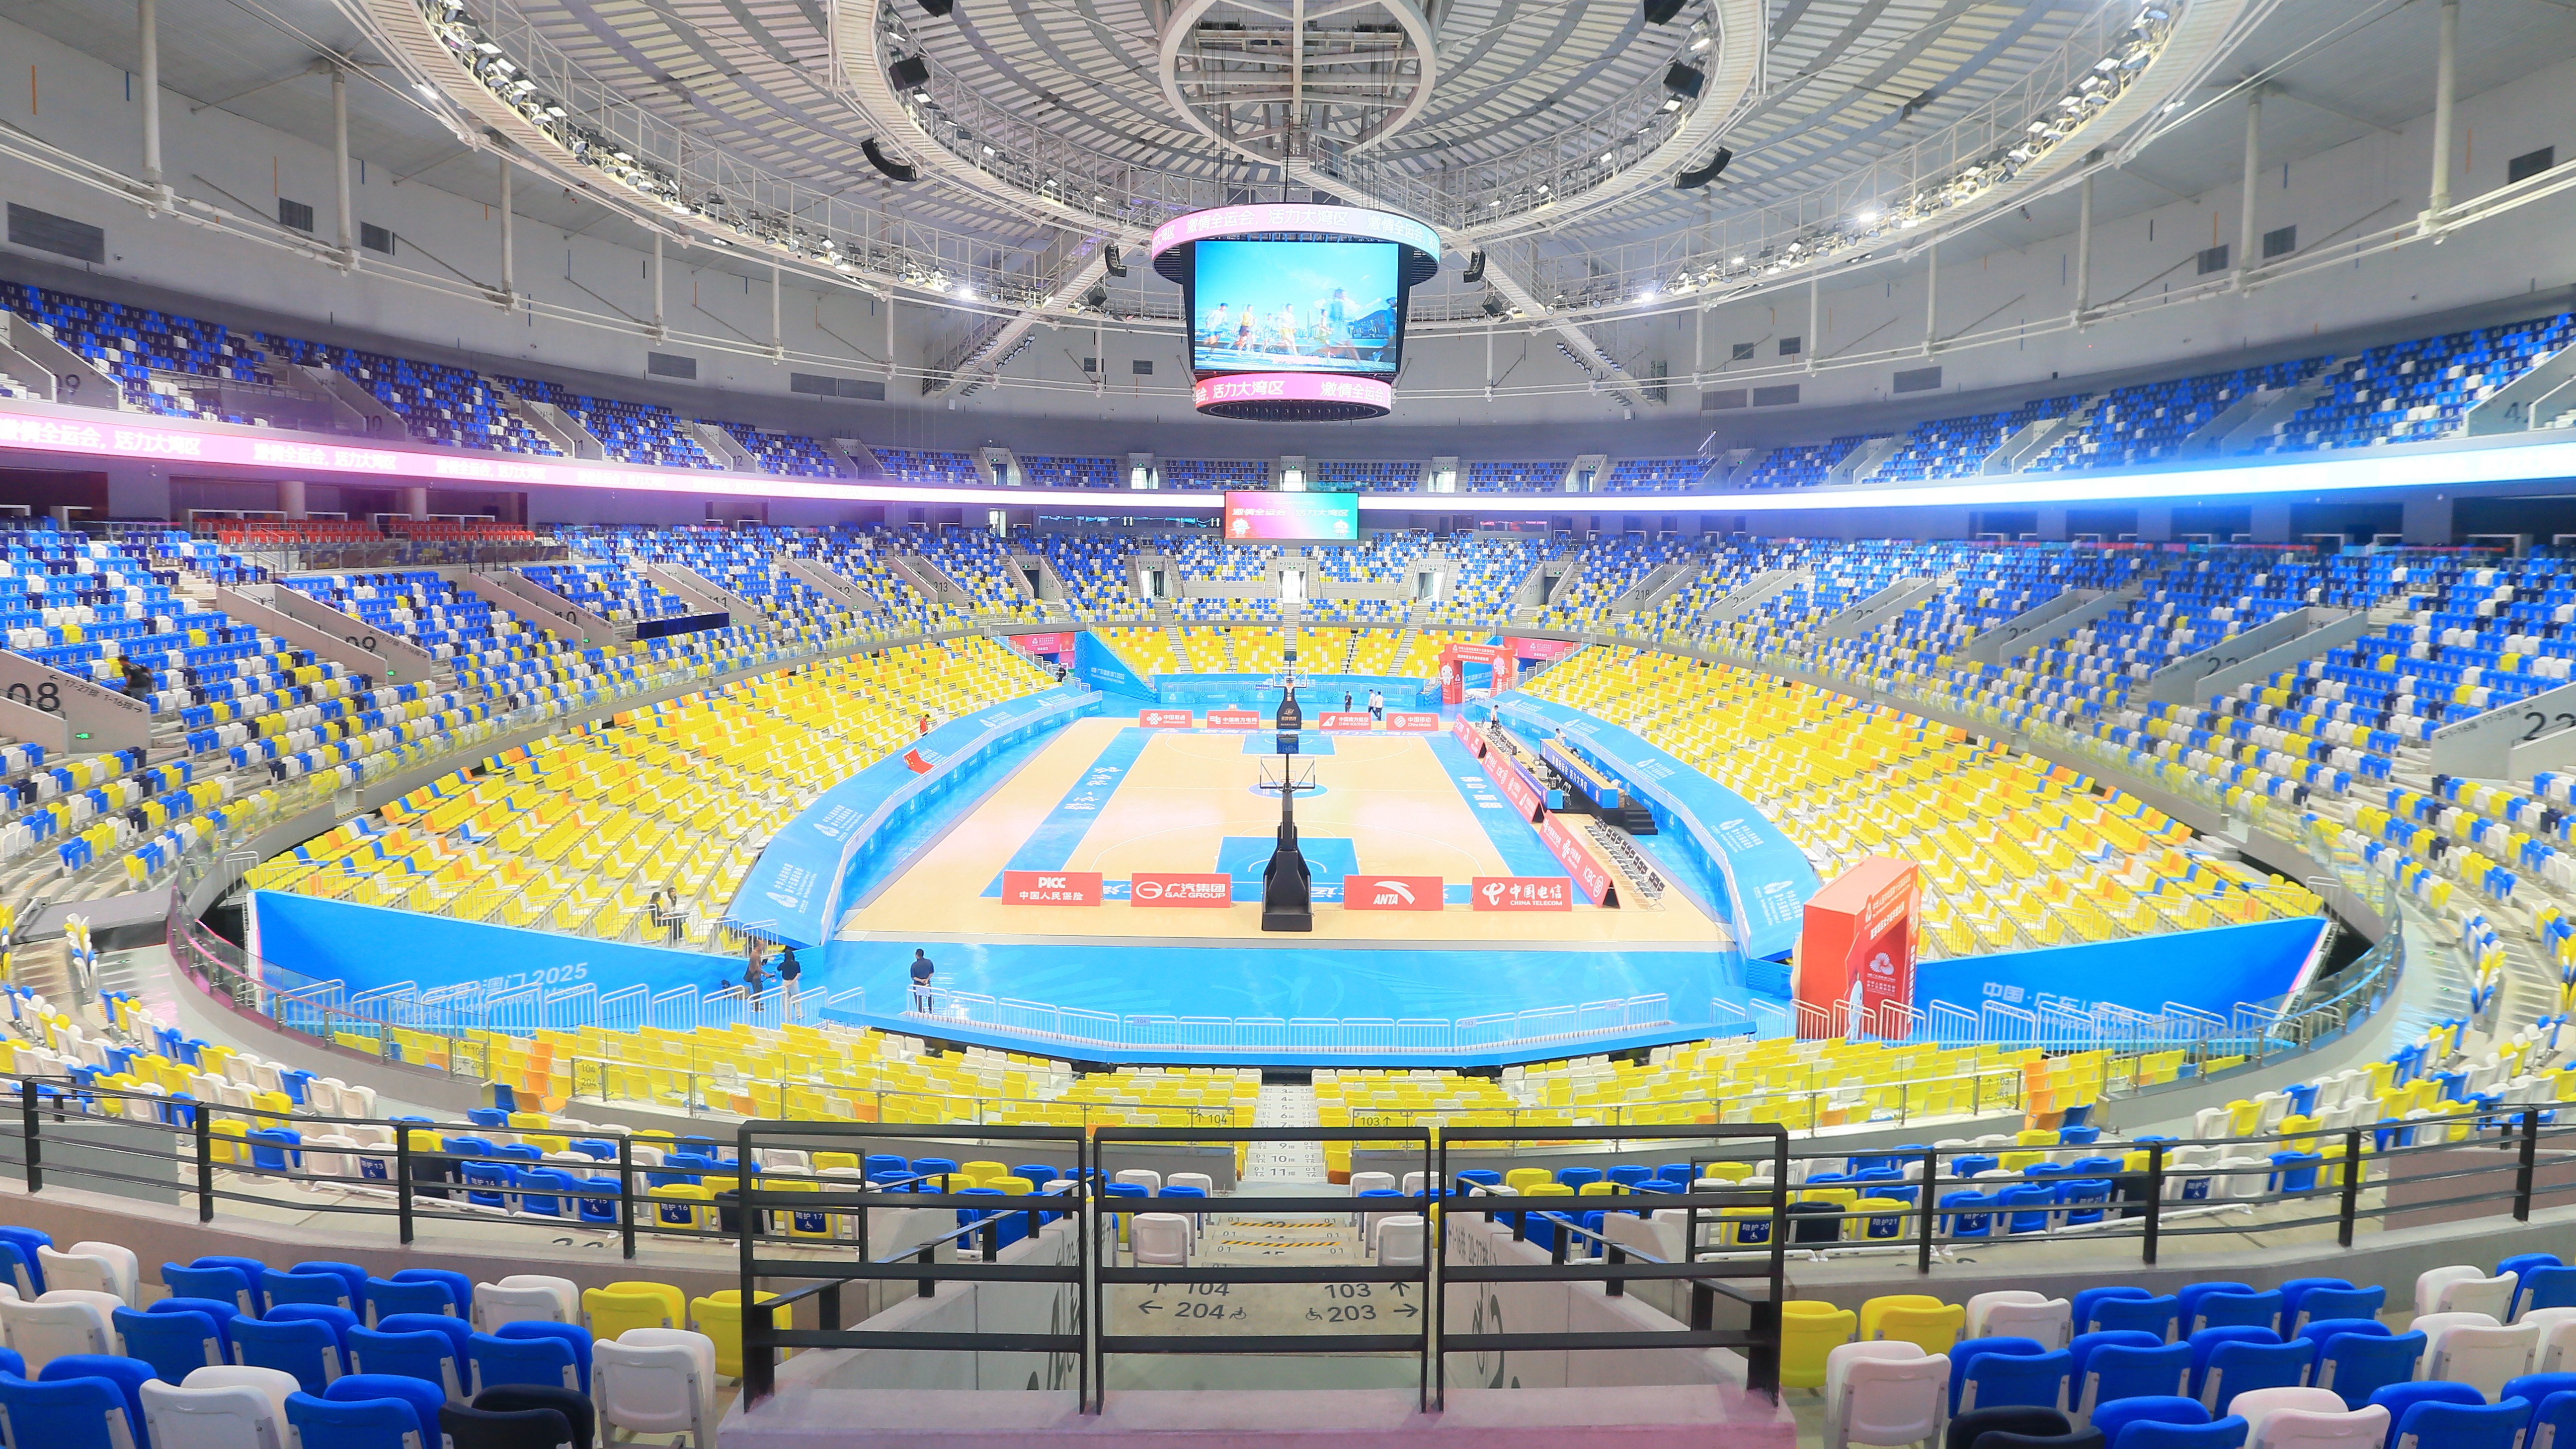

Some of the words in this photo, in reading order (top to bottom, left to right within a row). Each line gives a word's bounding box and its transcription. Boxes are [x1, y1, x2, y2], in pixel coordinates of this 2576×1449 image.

[934, 581, 948, 592] 213
[1635, 590, 1650, 600] 218
[65, 679, 99, 697] 17-27排
[103, 694, 134, 710] 1-16排
[1583, 865, 1596, 887] ICBC
[1038, 877, 1066, 888] PICC
[1165, 883, 1226, 892] 广汽集团
[1019, 890, 1083, 901] 中国人民保险
[1509, 884, 1563, 899] 中国电信
[1372, 893, 1399, 905] ANTA
[1208, 1114, 1227, 1124] 104
[1361, 1116, 1379, 1126] 103
[1187, 1282, 1230, 1296] 104
[1325, 1283, 1371, 1298] 103
[1175, 1302, 1224, 1320] 204
[1329, 1305, 1376, 1322] 203
